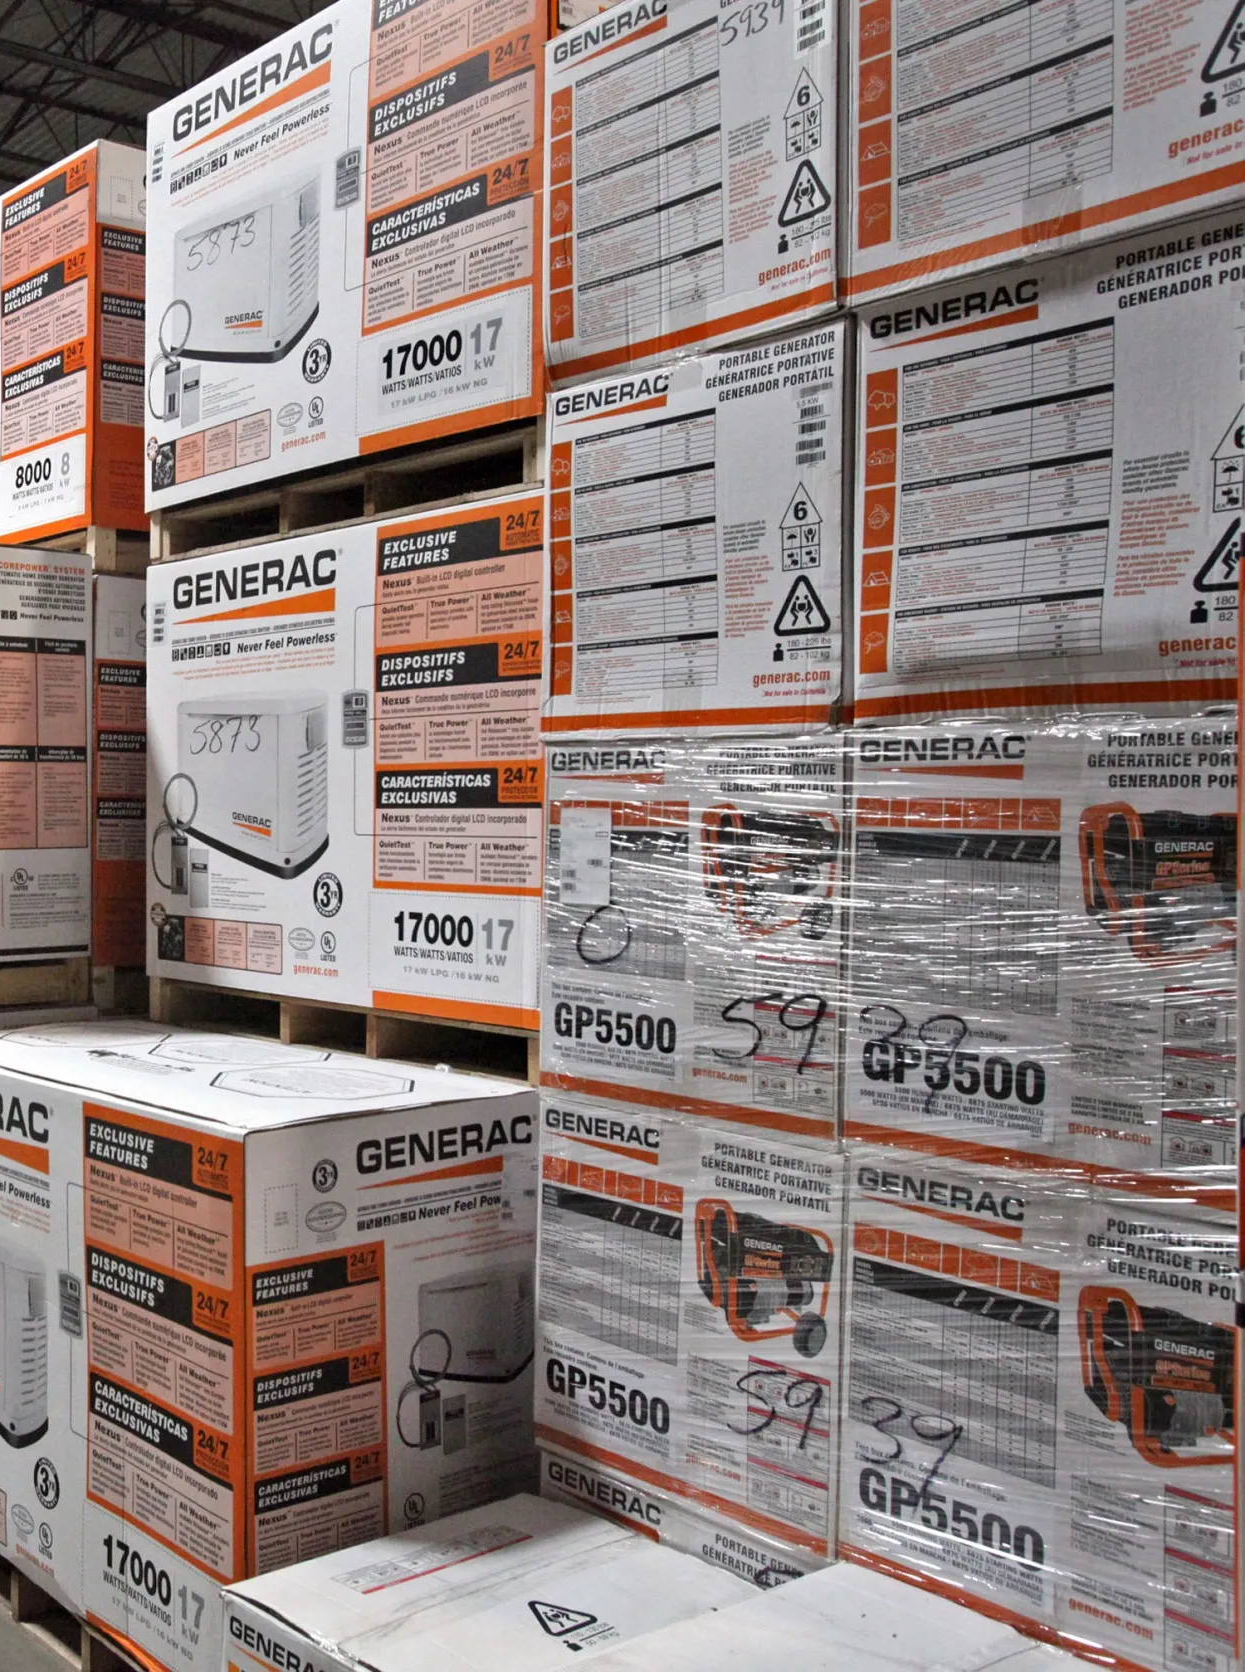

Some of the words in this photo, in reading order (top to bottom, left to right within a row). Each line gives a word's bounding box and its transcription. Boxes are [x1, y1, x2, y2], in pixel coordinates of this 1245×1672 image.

[494, 34, 530, 65] 24/7
[553, 1, 668, 65] GENERAC
[172, 25, 333, 142] GENERAC
[374, 72, 457, 121] DISPOSITIFS
[797, 85, 810, 107] 6
[233, 139, 259, 161] Never
[261, 127, 281, 147] Feel
[281, 104, 331, 140] Powerless
[373, 93, 446, 138] EXCLUSIFS
[1168, 118, 1244, 159] generac
[5, 187, 45, 217] EXCLUSIVE
[69, 160, 87, 179] 24/7
[492, 158, 529, 185] 24/7
[5, 201, 41, 229] FEATURES
[371, 182, 480, 236] CARACTERÍSTICAS
[187, 215, 255, 272] 5873
[371, 211, 447, 252] EXCLUSIVAS
[759, 248, 831, 286] generac.com
[1116, 236, 1195, 269] PORTABLE
[4, 273, 49, 302] DISPOSITIFS
[67, 252, 86, 271] 24/7
[1097, 255, 1203, 294] GÉNÉRATRICE
[1118, 274, 1212, 309] GENERADOR
[4, 288, 43, 313] EXCLUSIFS
[870, 278, 1039, 341] GENERAC
[382, 329, 462, 380] 17000
[470, 316, 502, 354] 17
[719, 347, 770, 371] PORTABLE
[773, 330, 835, 357] GENERATOR
[5, 355, 61, 387] CARACTERÍSTICAS
[5, 375, 44, 399] EXCLUSIVAS
[705, 363, 774, 390] GÉNÉRATRICE
[777, 347, 834, 374] PORTATIVE
[718, 378, 779, 403] GENERADOR
[782, 364, 834, 388] PORTÁTIL
[555, 374, 669, 417] GENERAC
[281, 430, 326, 453] generac.com
[15, 457, 52, 489] 8000
[61, 451, 70, 477] 8
[793, 500, 808, 521] 6
[383, 530, 457, 556] EXCLUSIVE
[506, 510, 540, 531] 24/7
[382, 576, 412, 590] Nexus
[416, 572, 437, 586] Built-in
[439, 569, 453, 582] LCD
[454, 567, 472, 582] digital
[474, 563, 506, 577] controller
[383, 548, 450, 571] FEATURES
[173, 549, 337, 610] GENERAC
[381, 603, 415, 615] QuietTest
[430, 599, 445, 609] True
[446, 596, 470, 607] Power
[481, 592, 493, 602] All
[494, 588, 527, 600] Weather
[237, 639, 262, 654] Never
[263, 637, 283, 652] Feel
[285, 632, 335, 650] Powerless
[381, 651, 465, 672] DISPOSITIFS
[503, 640, 539, 660] 24/7
[381, 669, 454, 688] EXCLUSIFS
[752, 668, 830, 688] generac.com
[189, 714, 262, 756] 5873
[859, 735, 1026, 763] GENERAC
[381, 771, 492, 790] CARACTERÍSTICAS
[502, 766, 538, 785] 24/7
[551, 749, 666, 772] GENERAC
[381, 791, 457, 805] EXCLUSIVAS
[232, 810, 271, 829] GENERAC
[381, 812, 410, 824] Nexus
[415, 812, 449, 825] Controlador
[450, 812, 470, 826] digital
[472, 812, 485, 824] LCD
[487, 812, 527, 826] incorporado
[1154, 841, 1214, 853] GENERAC
[394, 910, 474, 948] 17000
[481, 917, 514, 952] 17
[292, 963, 339, 978] generac.com
[554, 1001, 677, 1054] GP5500
[862, 1039, 1046, 1106] GP5500
[89, 1122, 154, 1153] EXCLUSIVE
[197, 1146, 228, 1171] 24/7
[356, 1115, 533, 1174] GENERAC
[545, 1108, 661, 1149] GENERAC
[1067, 1121, 1151, 1146] generac.com
[89, 1140, 148, 1171] FEATURES
[714, 1142, 767, 1163] PORTABLE
[769, 1154, 832, 1177] GENERATOR
[8, 1181, 51, 1209] Powerless
[857, 1166, 1024, 1221] GENERAC
[91, 1252, 165, 1294] DISPOSITIFS
[196, 1290, 229, 1318] 24/7
[91, 1269, 156, 1307] EXCLUSIFS
[255, 1269, 314, 1289] EXCLUSIVE
[350, 1250, 376, 1267] 24/7
[255, 1282, 309, 1300] FEATURES
[1154, 1338, 1215, 1361] GENERAC
[257, 1368, 323, 1392] DISPOSITIFS
[352, 1352, 380, 1371] 24/7
[257, 1382, 315, 1404] EXCLUSIFS
[546, 1358, 670, 1435] GP5500
[94, 1380, 188, 1442] CARACTERÍSTICAS
[197, 1429, 229, 1457] 24/7
[94, 1398, 160, 1443] EXCLUSIVAS
[258, 1464, 347, 1496] CARACTERÍSTICAS
[354, 1452, 380, 1469] 24/7
[547, 1461, 662, 1526] GENERAC
[258, 1484, 319, 1509] EXCLUSIVAS
[859, 1466, 1044, 1572] GP5500
[715, 1533, 768, 1566] PORTABLE
[104, 1534, 171, 1606] 17000
[178, 1585, 206, 1631] 17
[1068, 1597, 1154, 1641] generac.com
